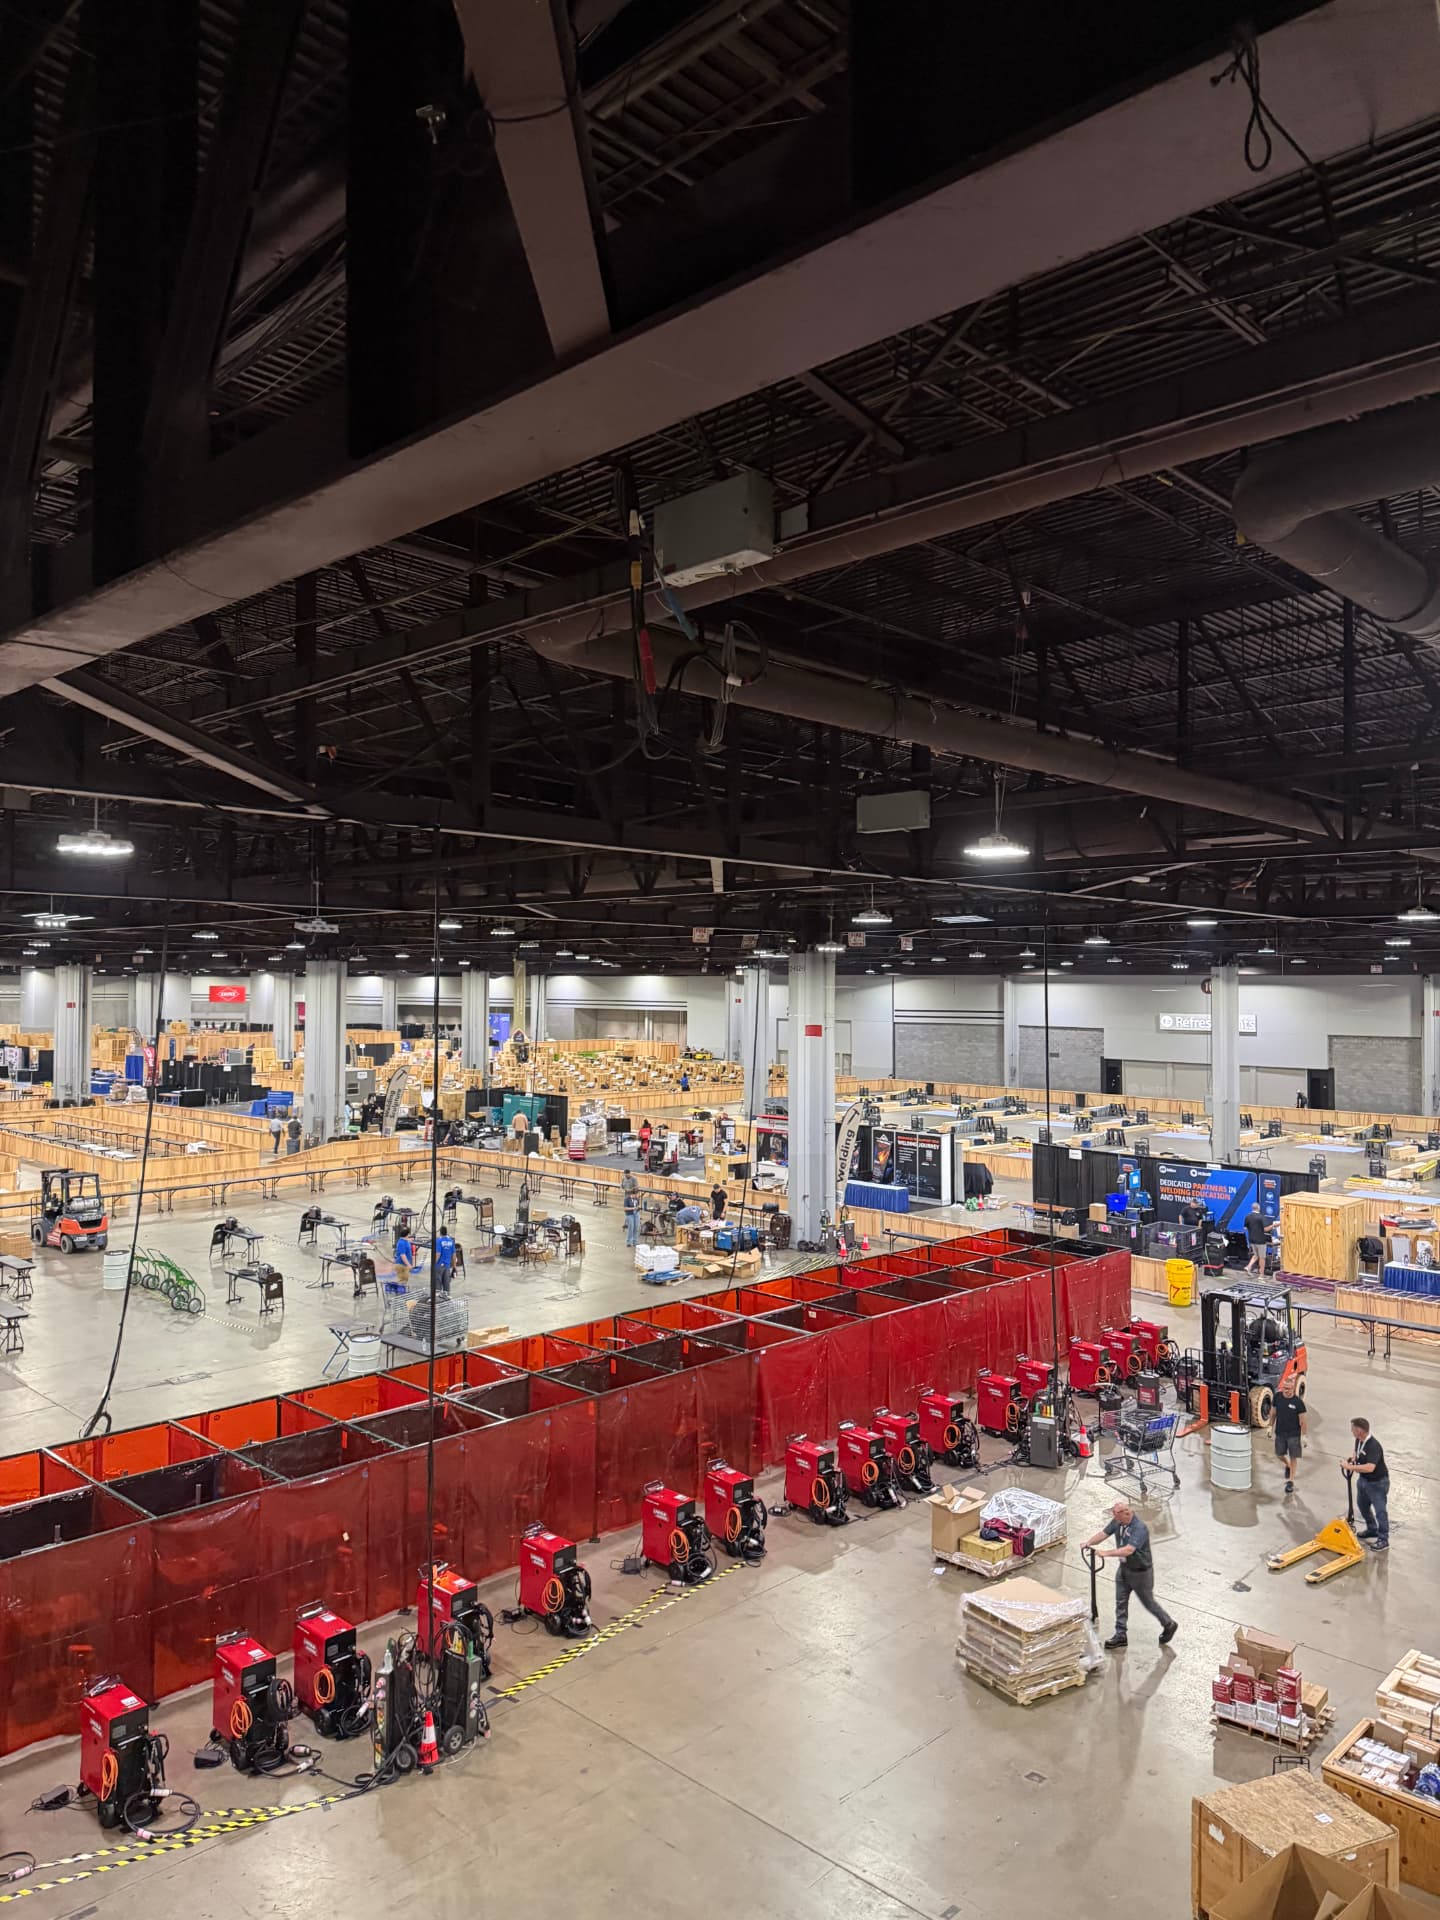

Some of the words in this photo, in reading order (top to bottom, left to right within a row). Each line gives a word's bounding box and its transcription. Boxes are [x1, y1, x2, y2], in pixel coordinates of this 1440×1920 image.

[1176, 1016, 1256, 1029] Refresnts
[837, 1129, 855, 1183] Welding
[1160, 1178, 1192, 1189] DEDICATED
[1192, 1182, 1227, 1193] PARTNERS
[1228, 1186, 1237, 1194] IN
[1160, 1186, 1191, 1196] WELDING
[1191, 1190, 1230, 1201] EDUCATION
[1160, 1193, 1174, 1202] AND
